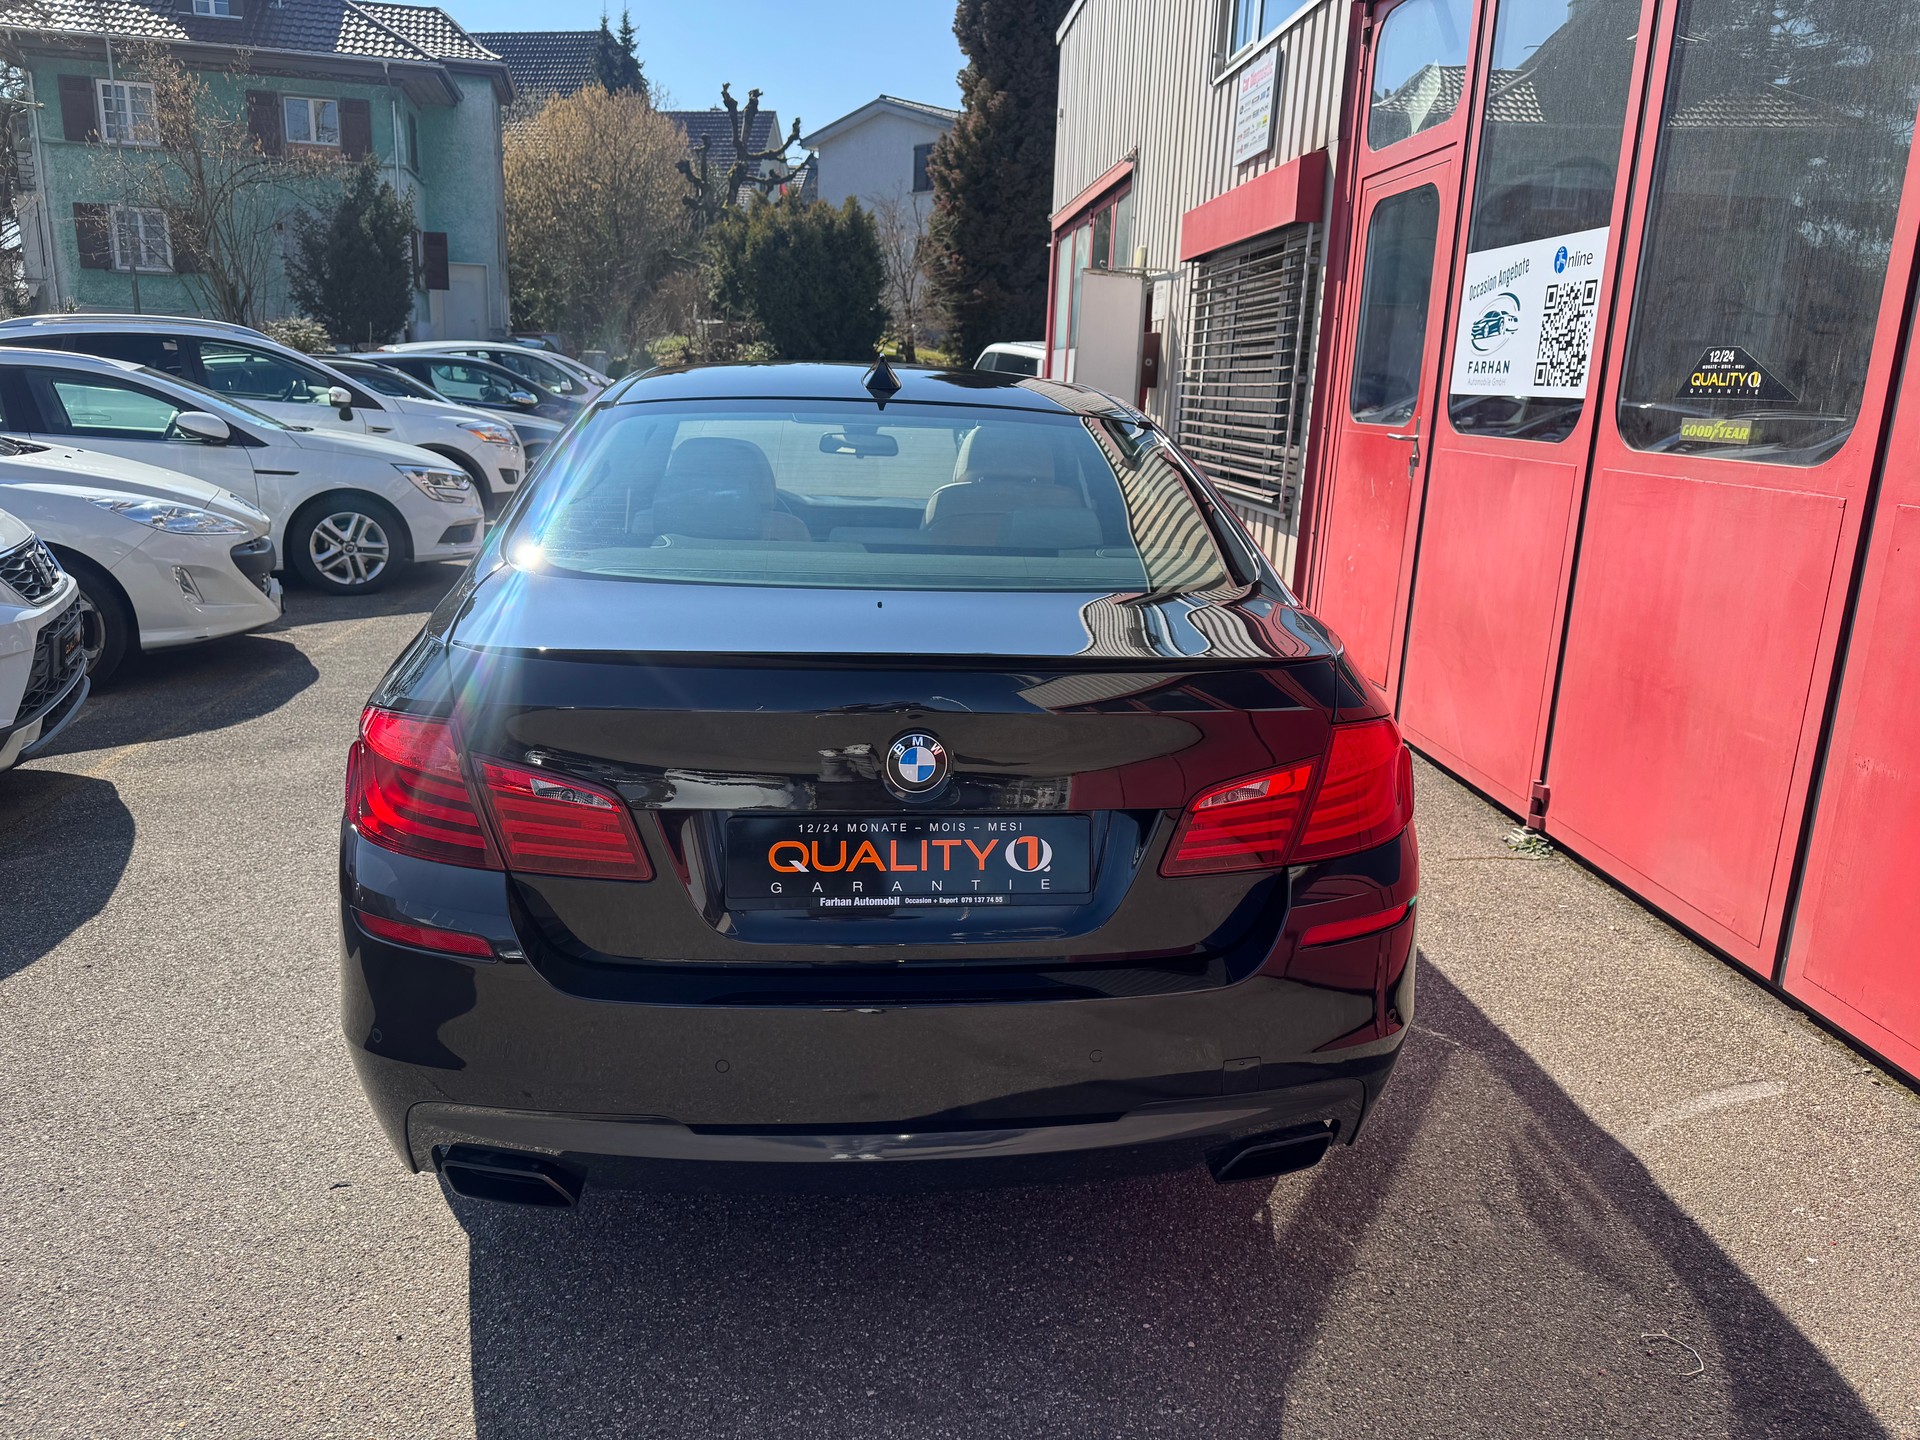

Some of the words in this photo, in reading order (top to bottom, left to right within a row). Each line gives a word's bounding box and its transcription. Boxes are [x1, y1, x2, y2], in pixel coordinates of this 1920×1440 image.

[1469, 275, 1497, 301] Occasion
[1498, 258, 1530, 289] Angebote
[1710, 350, 1734, 362] 12/24
[1468, 360, 1510, 374] FARHAN
[1492, 378, 1506, 386] GmbH
[1691, 372, 1748, 386] QUALITY
[1682, 421, 1748, 440] GOODYEAR
[893, 736, 943, 757] BMW
[798, 824, 839, 833] 12/24
[847, 823, 907, 832] MONATE
[930, 823, 966, 831] MOIS
[988, 823, 1023, 831] MESI
[768, 839, 999, 873] QUALITY
[770, 878, 1051, 894] GARANTIE
[820, 897, 852, 907] Farhan
[854, 897, 900, 906] Automobil
[939, 897, 958, 905] Export
